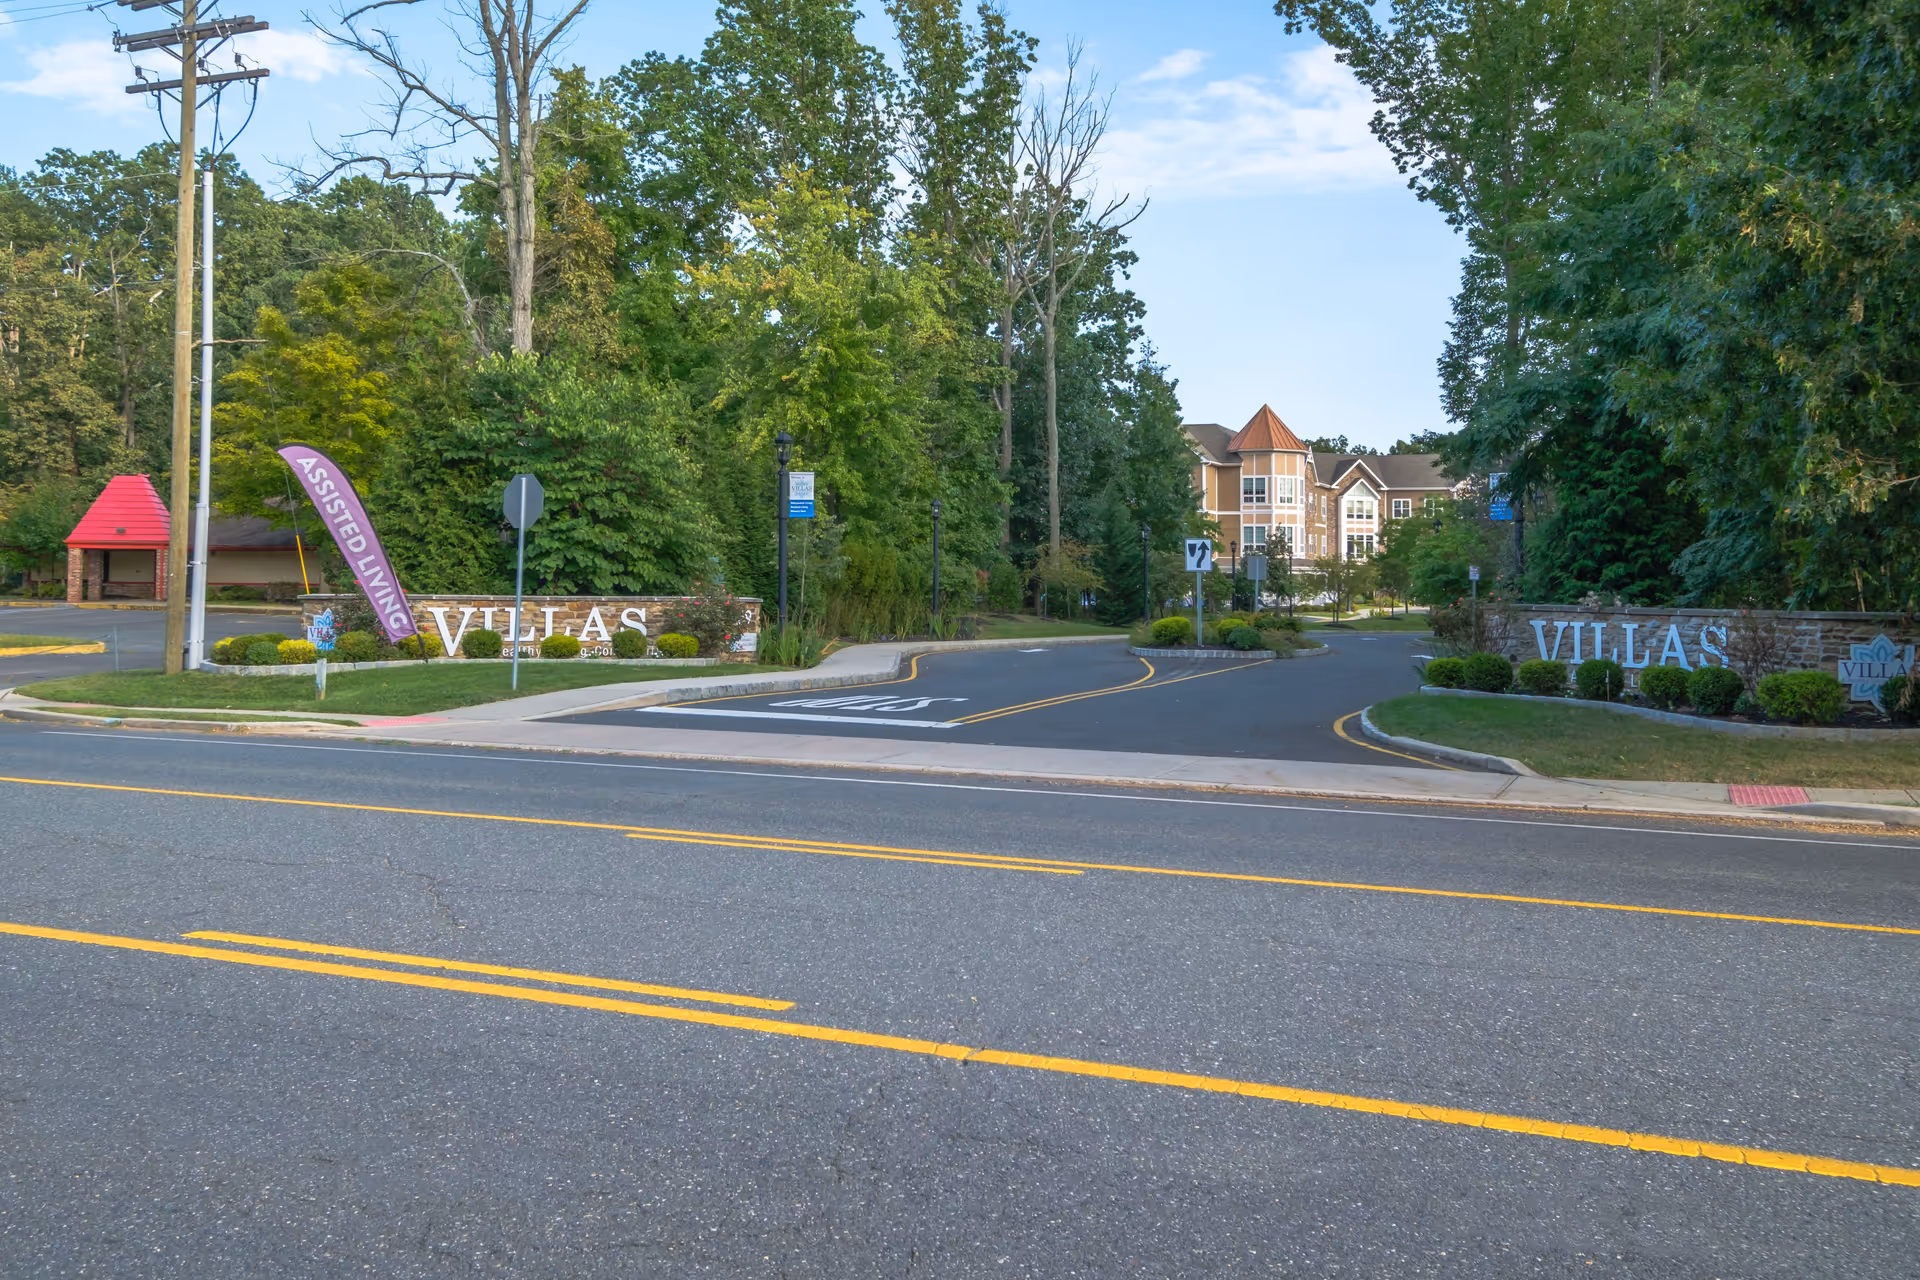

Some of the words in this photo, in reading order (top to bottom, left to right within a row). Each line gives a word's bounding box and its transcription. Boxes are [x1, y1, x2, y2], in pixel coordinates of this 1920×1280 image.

[297, 458, 366, 553] ASSISTED
[357, 554, 407, 630] LIVING
[427, 607, 647, 656] VILLAS
[1529, 620, 1728, 672] VILLAS
[1841, 661, 1908, 679] VILLA
